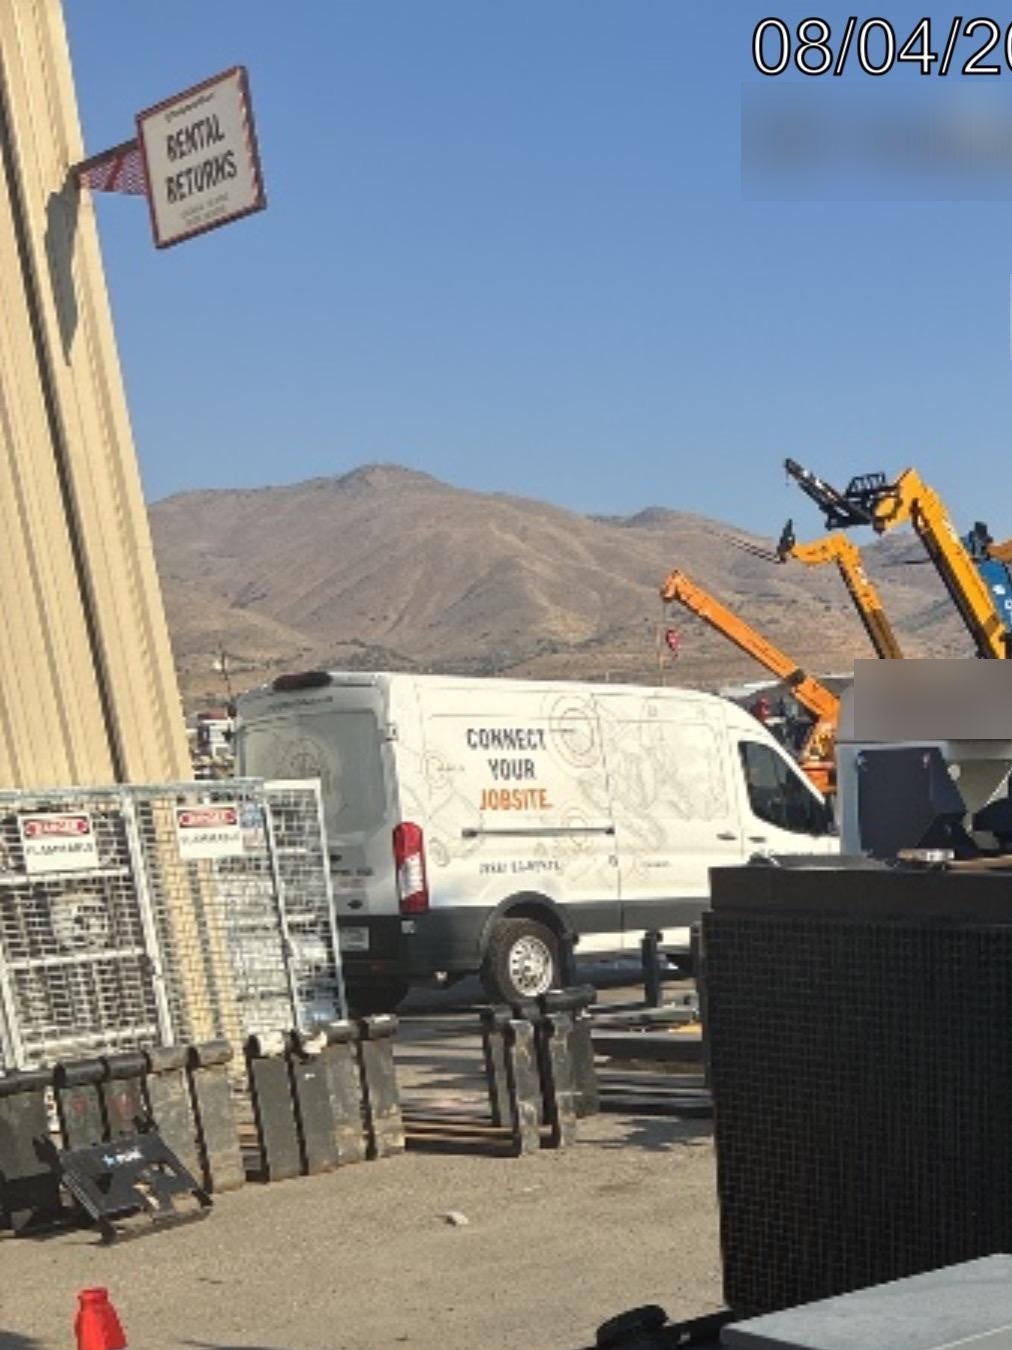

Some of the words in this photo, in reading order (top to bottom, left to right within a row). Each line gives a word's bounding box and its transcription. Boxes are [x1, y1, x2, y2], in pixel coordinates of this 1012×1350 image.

[166, 113, 225, 163] RENTAL
[165, 149, 238, 204] RETURNS
[466, 727, 547, 751] CONNECT
[487, 757, 537, 782] YOUR
[479, 788, 553, 811] JOBSITE.
